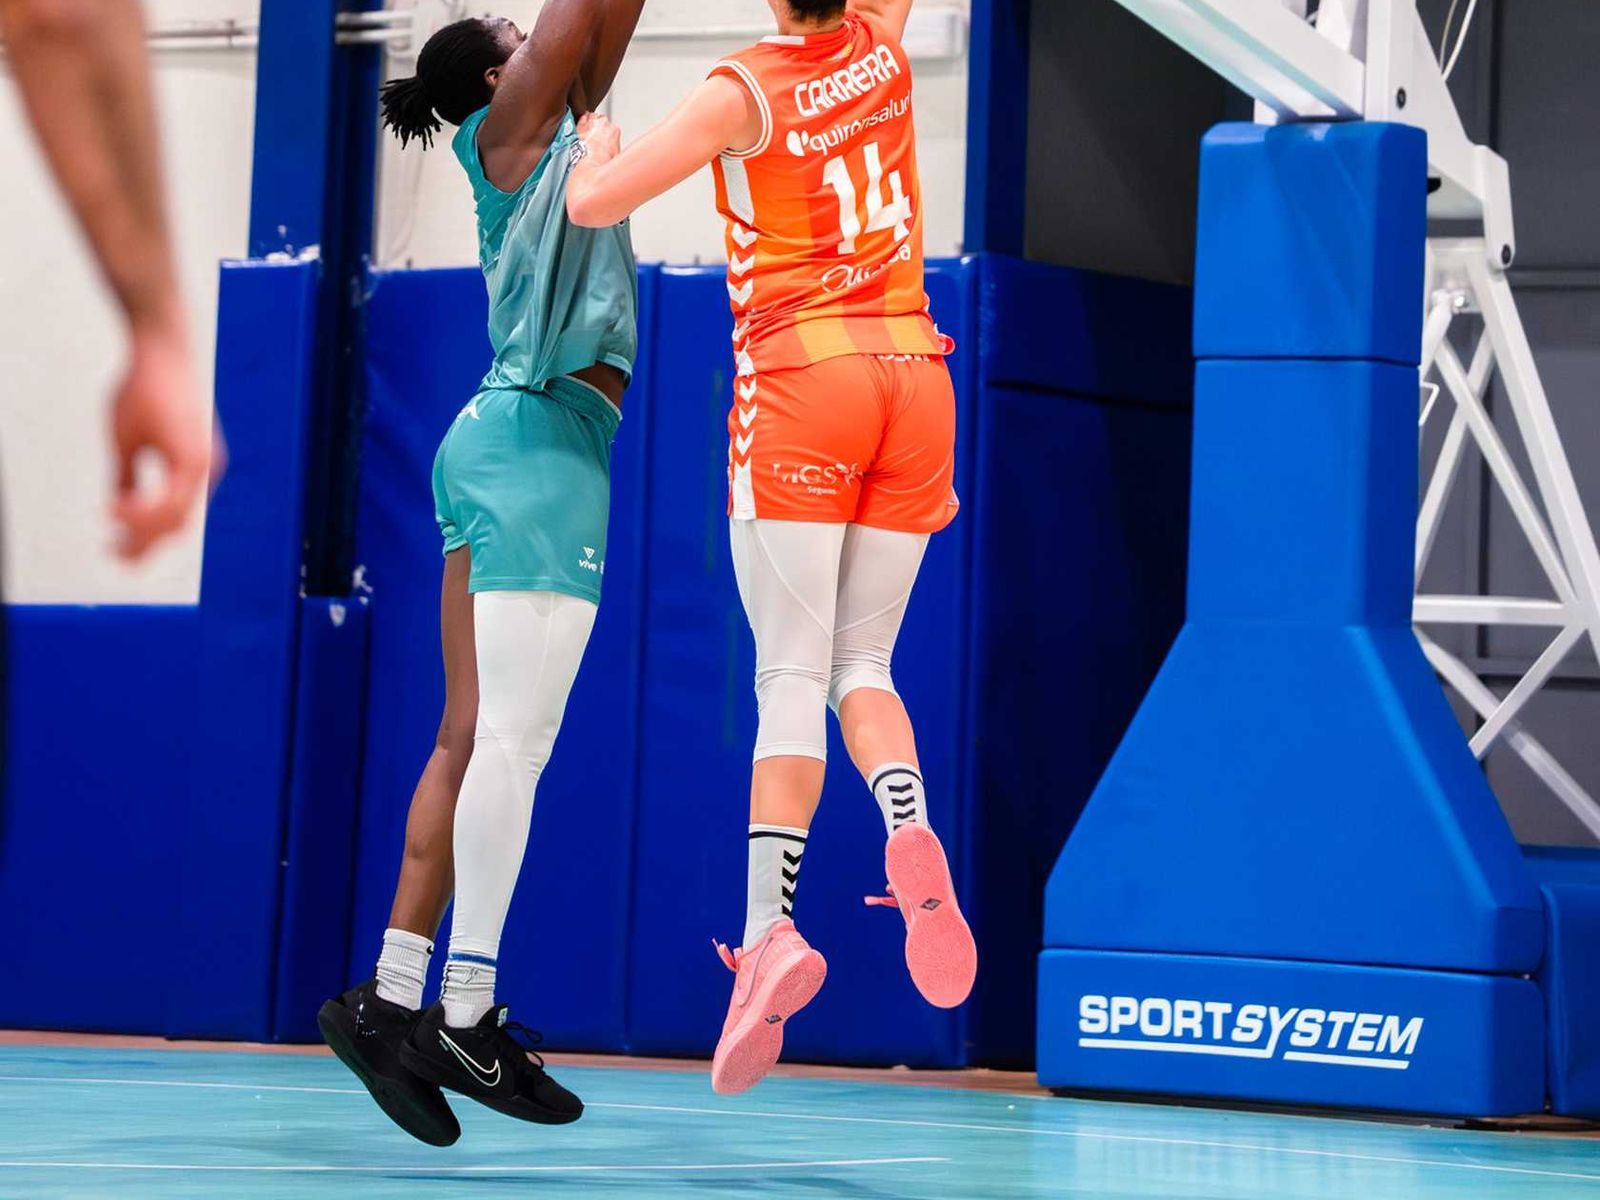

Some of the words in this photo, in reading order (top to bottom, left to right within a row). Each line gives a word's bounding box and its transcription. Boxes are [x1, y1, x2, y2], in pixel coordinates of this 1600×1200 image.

[794, 43, 900, 117] CARRERA
[822, 141, 912, 255] 14
[1079, 995, 1424, 1057] SPORTSYSTEM
